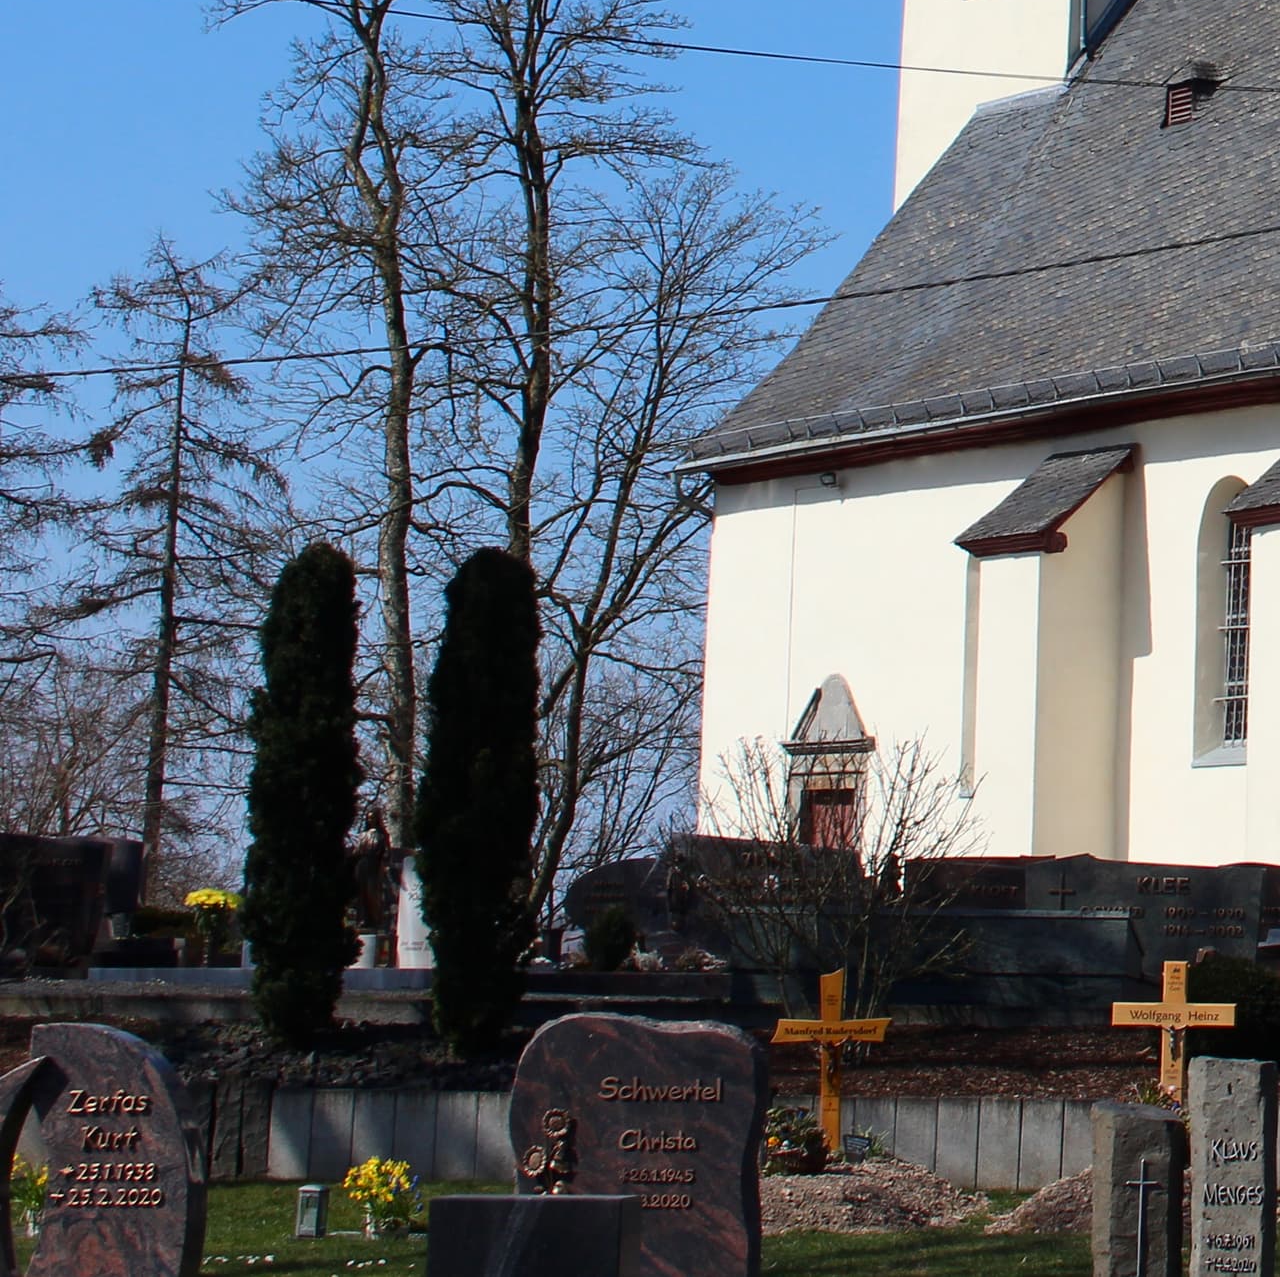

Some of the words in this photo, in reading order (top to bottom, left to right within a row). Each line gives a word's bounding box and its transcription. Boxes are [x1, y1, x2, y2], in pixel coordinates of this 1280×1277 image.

[1137, 876, 1192, 895] KLEE
[1129, 1009, 1181, 1022] Wolfgang
[1188, 1010, 1220, 1021] Heinz
[784, 1026, 824, 1035] Manfred
[597, 1076, 722, 1102] Schwertel
[66, 1089, 150, 1114] Zerfas
[80, 1125, 139, 1149] Kurt
[618, 1129, 697, 1151] Christa
[1211, 1137, 1258, 1160] KLAUS
[1202, 1182, 1264, 1206] MENGES
